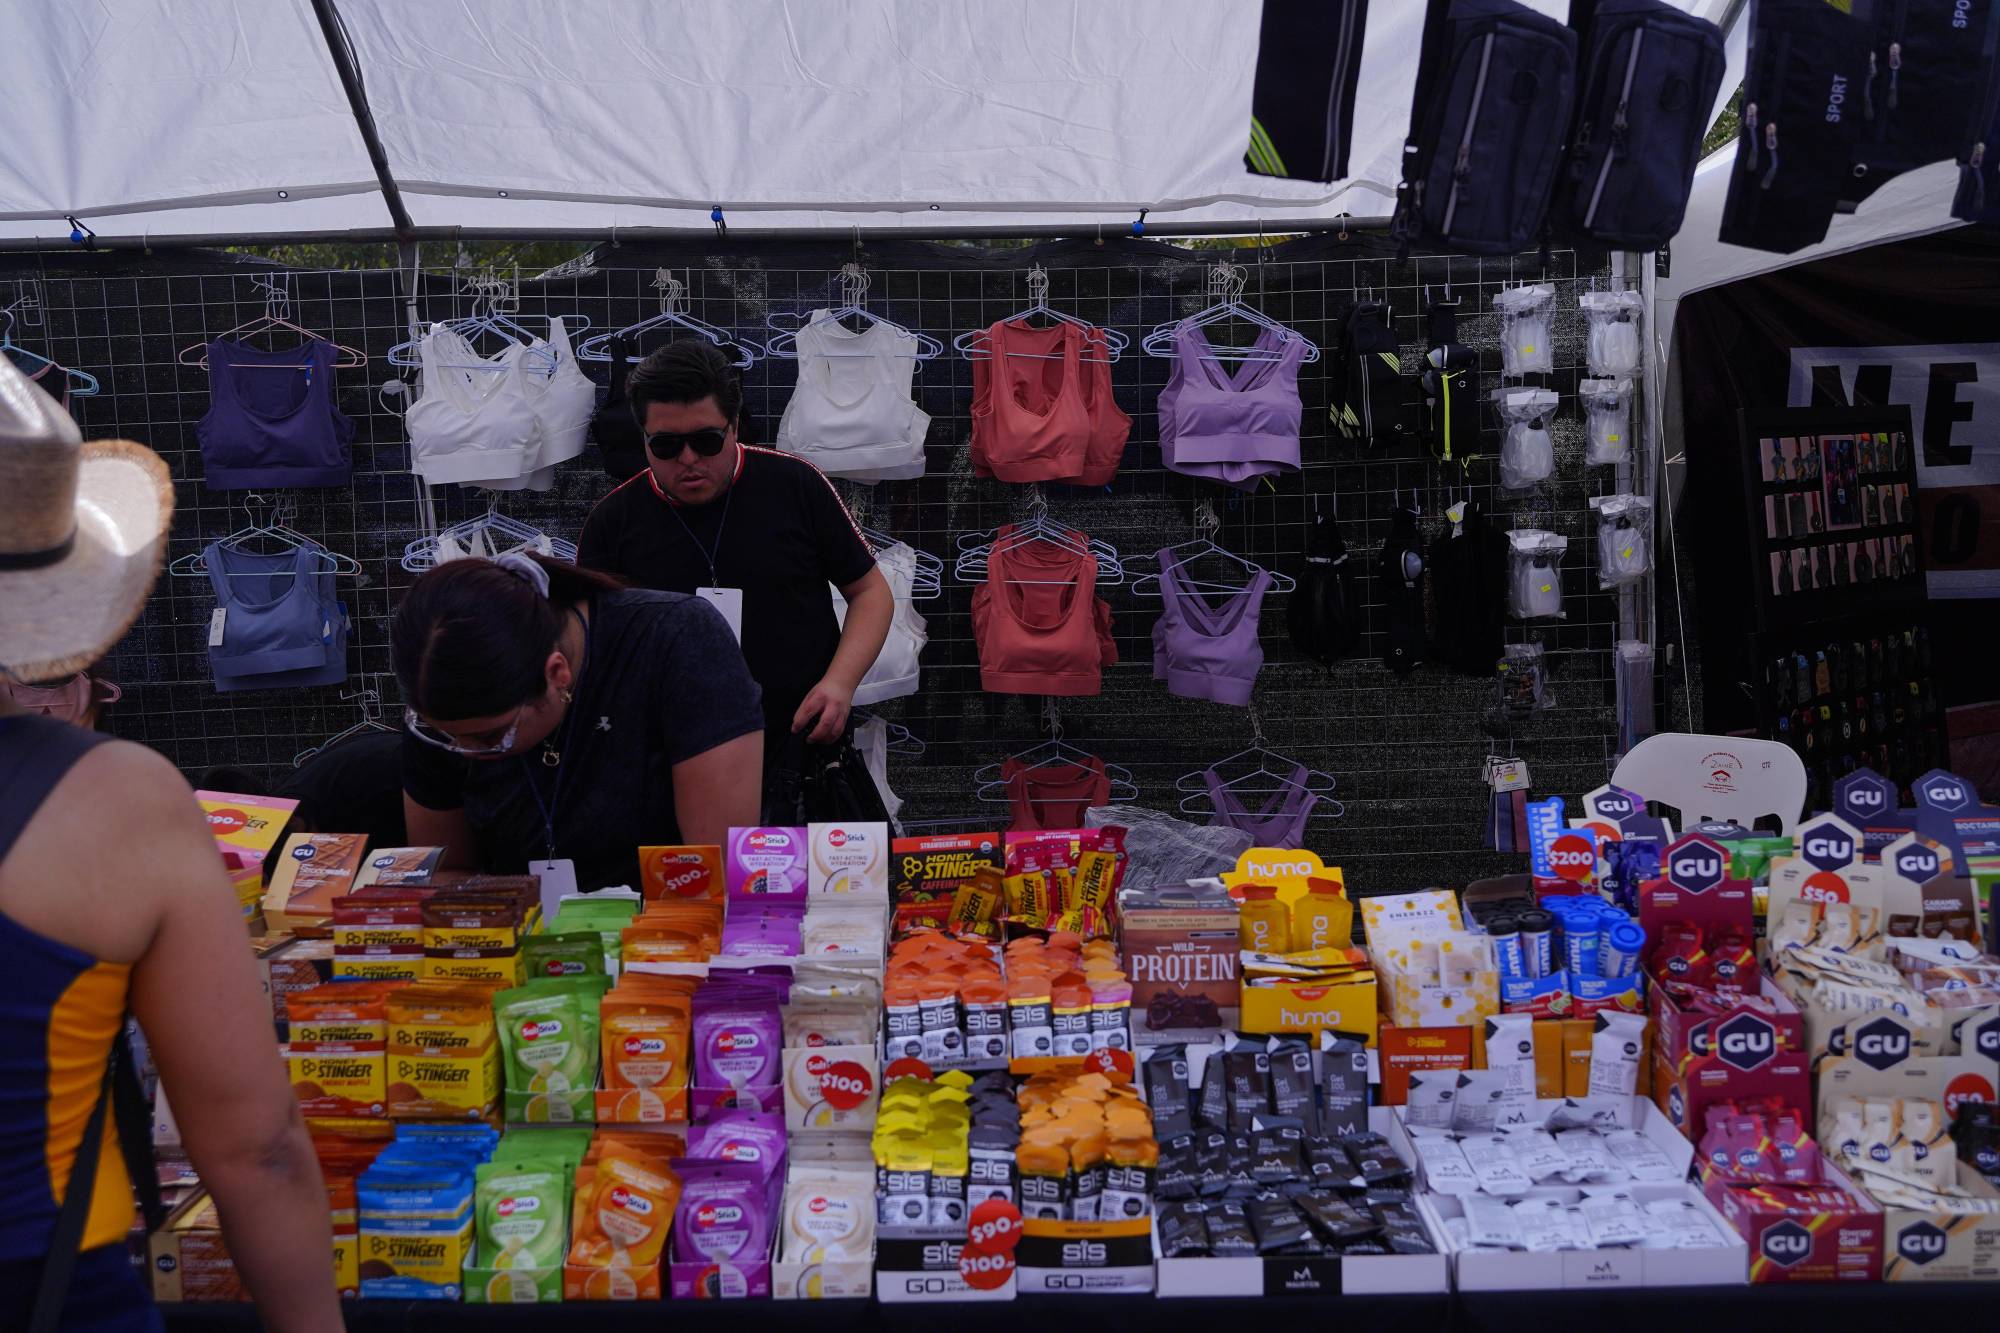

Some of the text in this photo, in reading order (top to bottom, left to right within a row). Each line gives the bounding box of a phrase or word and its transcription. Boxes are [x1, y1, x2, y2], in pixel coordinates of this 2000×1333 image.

[1951, 0, 1972, 29] SPO
[1825, 73, 1848, 123] SPORT
[1849, 789, 1883, 806] GU
[1929, 787, 1963, 801] GU
[1597, 800, 1630, 812] GU
[1531, 806, 1545, 873] HYDRATION
[293, 848, 314, 857] GU
[1806, 838, 1851, 860] GU
[374, 857, 395, 866] GU
[926, 852, 975, 863] HONEY
[1549, 851, 1594, 866] $200
[1899, 855, 1937, 872] GU
[1247, 860, 1313, 878] huma
[1674, 858, 1719, 878] GU
[920, 880, 968, 891] CAFFEINAT
[1085, 857, 1105, 905] STINGER
[1603, 879, 1619, 888] GU
[1172, 941, 1195, 952] WILD
[1131, 953, 1236, 982] PROTEIN
[1668, 961, 1688, 972] GU
[1717, 964, 1738, 974] GU
[1280, 1007, 1342, 1026] huma
[1693, 1033, 1708, 1050] G
[1722, 1031, 1771, 1054] GU
[1858, 1034, 1908, 1055] GU
[1979, 1031, 2000, 1049] G
[317, 1064, 373, 1079] STINGER
[414, 1068, 470, 1082] STINGER
[821, 1072, 864, 1094] $100
[1739, 1153, 1760, 1165] GU
[1871, 1149, 1889, 1158] GU
[1976, 1151, 1999, 1163] GU
[970, 1215, 1011, 1244] $90
[1766, 1235, 1809, 1253] GU
[1838, 1236, 1862, 1247] Gel
[1901, 1234, 1943, 1252] GU
[387, 1243, 446, 1258] STINGER
[959, 1254, 1006, 1276] $100
[906, 1278, 945, 1294] GO
[1045, 1274, 1084, 1289] GO
